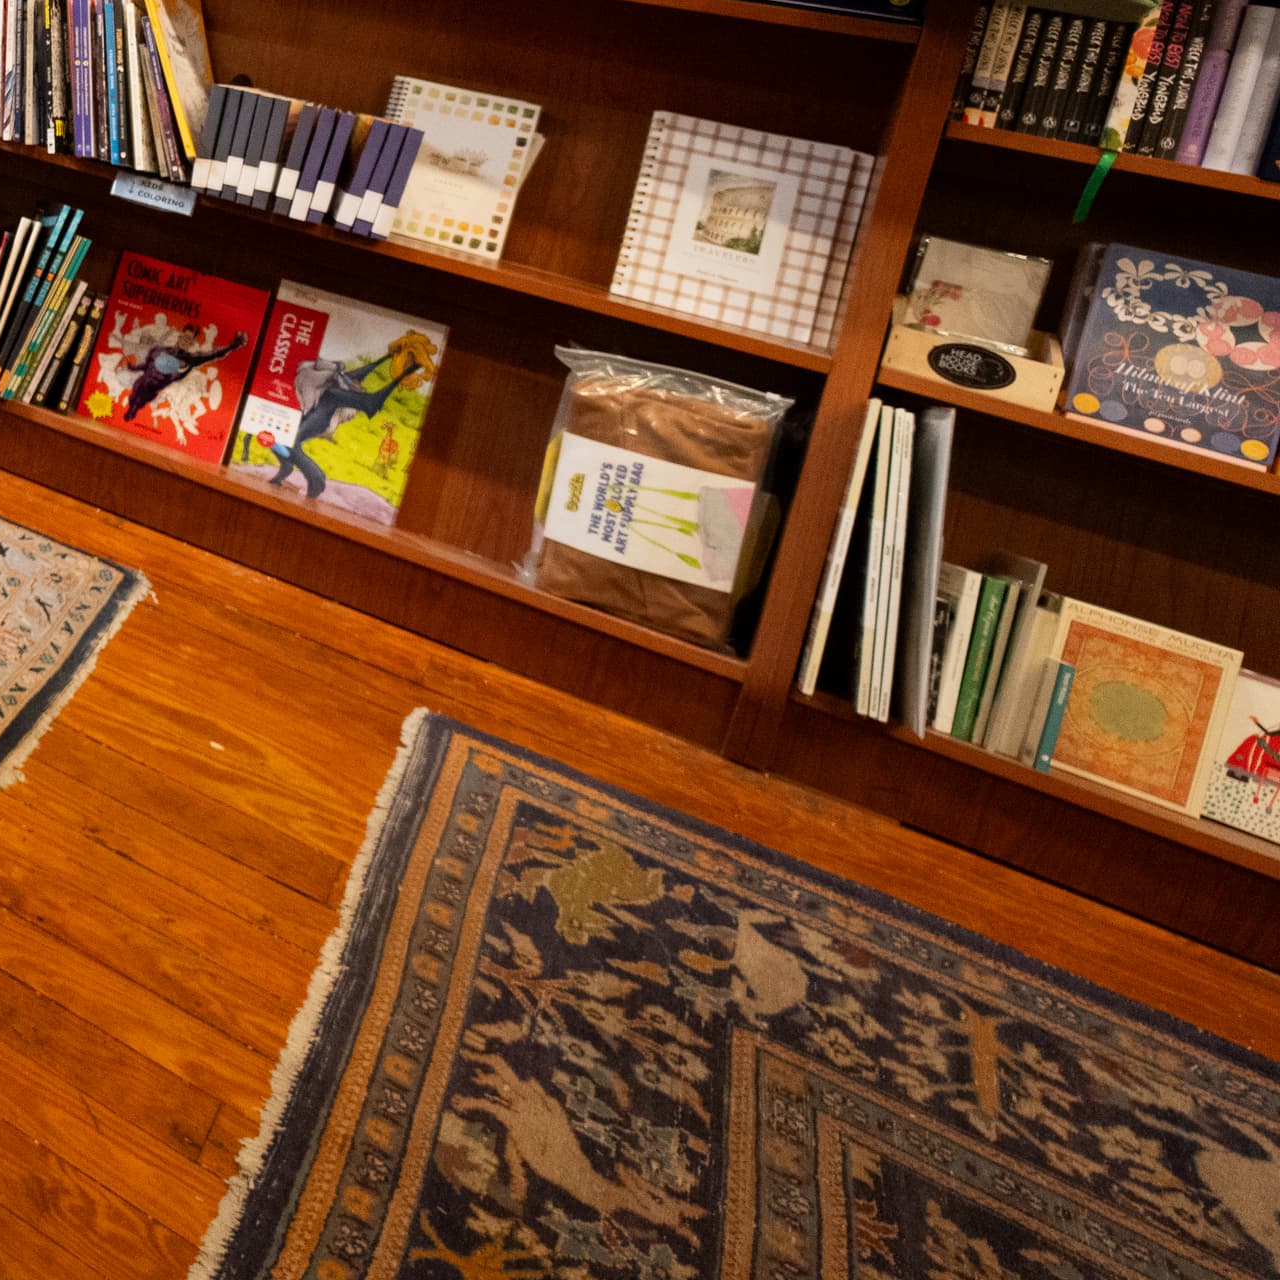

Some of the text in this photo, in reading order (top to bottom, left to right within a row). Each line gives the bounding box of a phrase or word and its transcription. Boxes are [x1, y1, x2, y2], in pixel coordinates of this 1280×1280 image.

[137, 190, 185, 208] COLORING
[140, 179, 163, 191] KIDS
[127, 259, 191, 292] COMIC ART
[122, 281, 202, 319] SUPERHEROES
[267, 312, 297, 375] CLASSICS
[293, 318, 315, 347] THE
[939, 360, 977, 376] BOOKS
[940, 354, 978, 369] HOUSE
[951, 348, 982, 362] HEAD
[1114, 363, 1246, 405] Hilma Klint
[1123, 380, 1150, 398] The
[1175, 395, 1230, 417] Largest
[588, 462, 613, 535] THE WORLD'S
[615, 531, 628, 555] ART
[630, 462, 644, 485] BAG
[601, 512, 617, 543] MOST
[1067, 602, 1236, 661] ALPHONSE MUCHA
